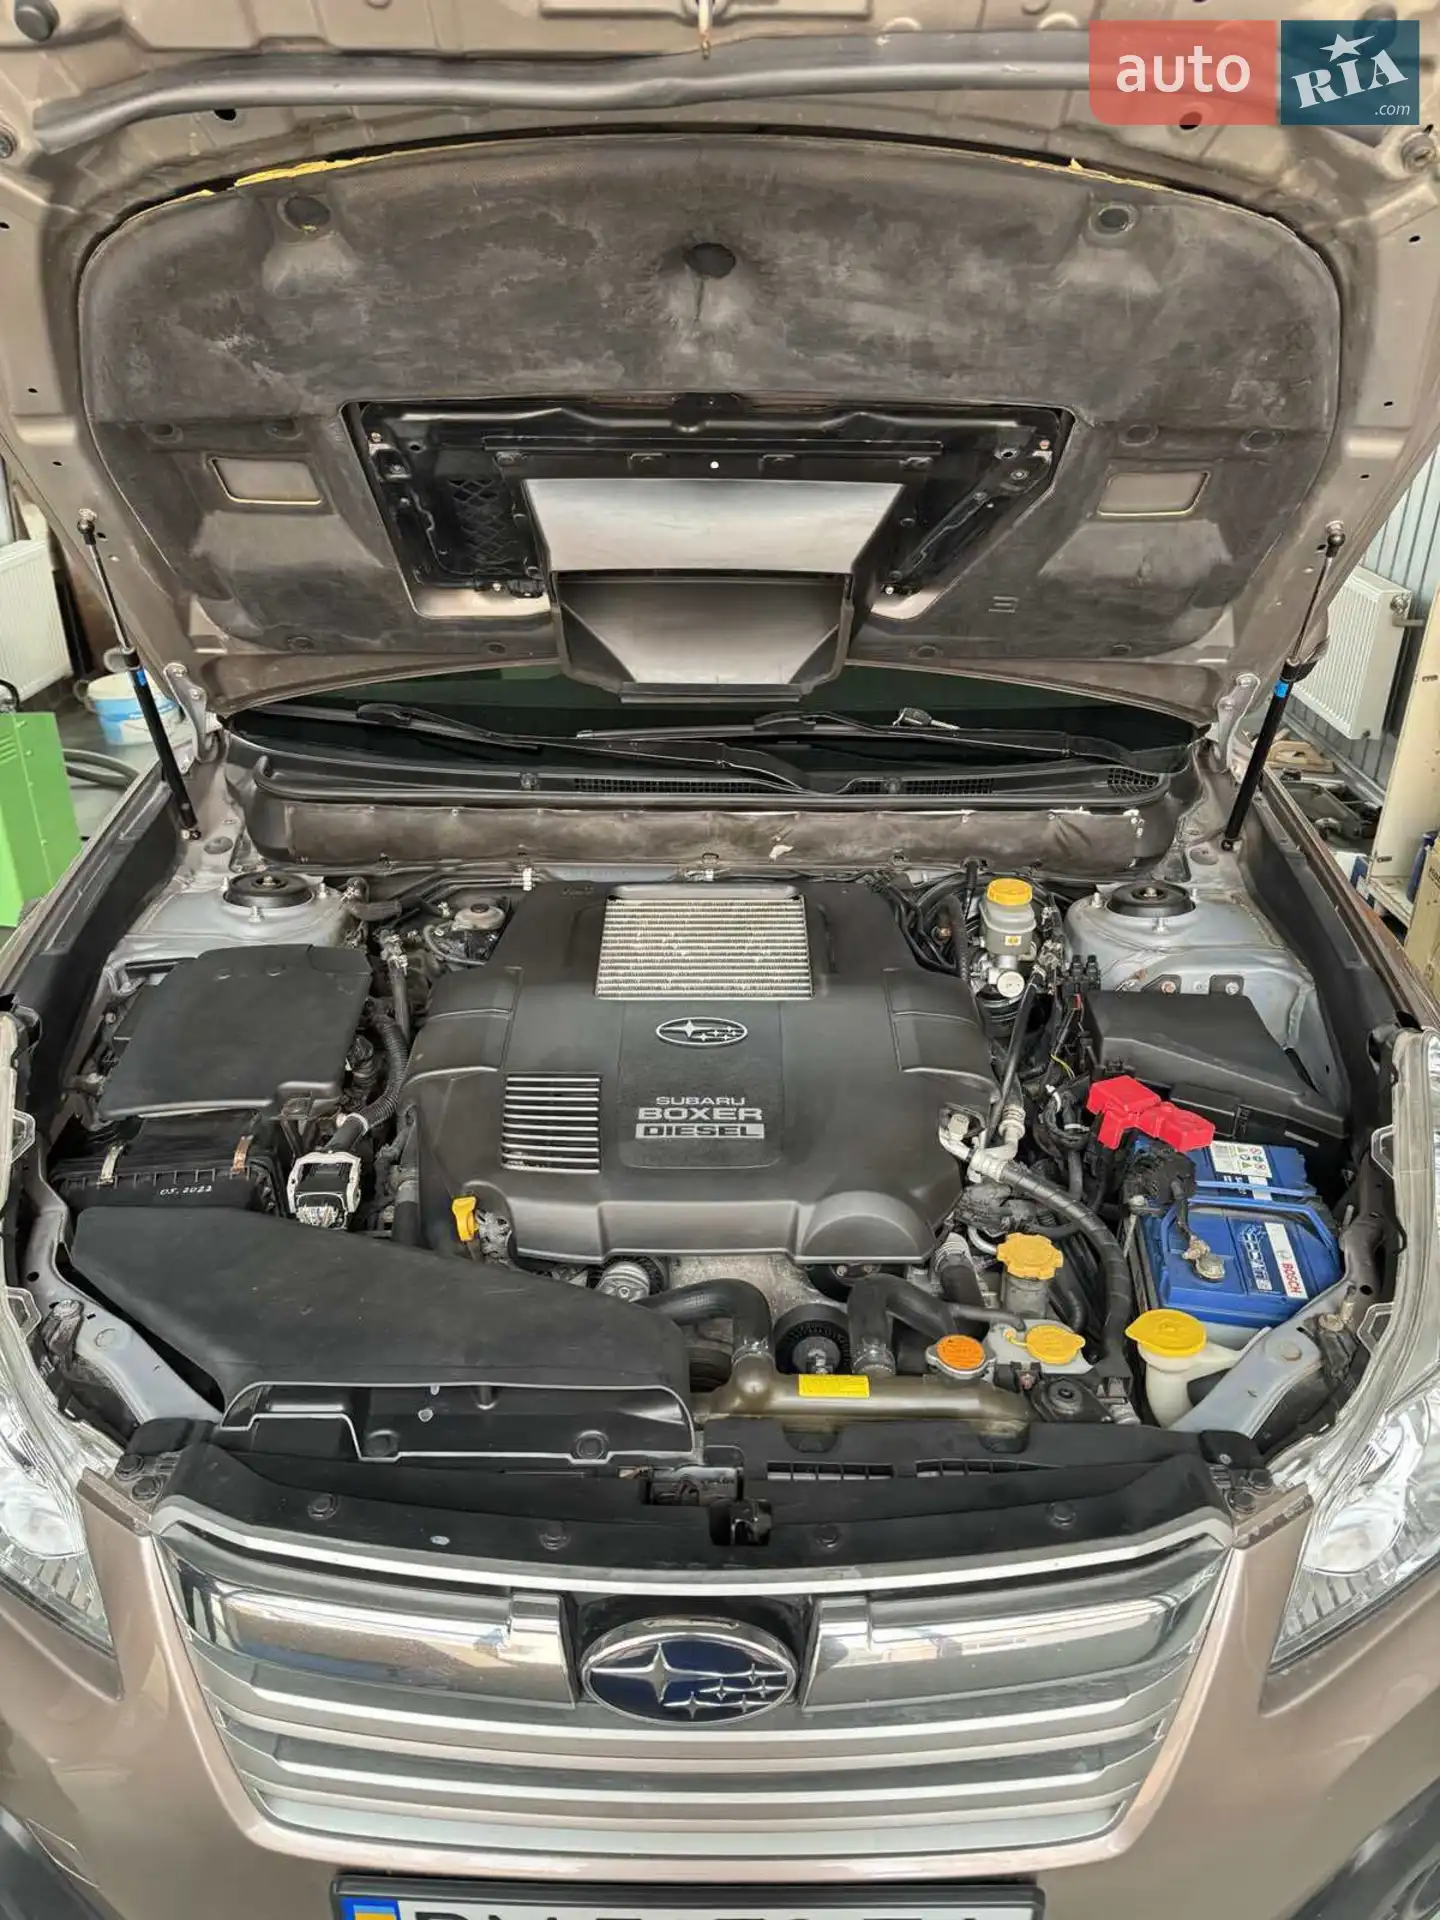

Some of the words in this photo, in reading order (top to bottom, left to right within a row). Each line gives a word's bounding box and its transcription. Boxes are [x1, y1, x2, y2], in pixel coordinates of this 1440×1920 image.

[656, 1096, 746, 1105] SUBARU
[637, 1107, 763, 1121] BOXER
[640, 1124, 762, 1137] DIESEL
[1281, 1262, 1303, 1294] BOSCH
